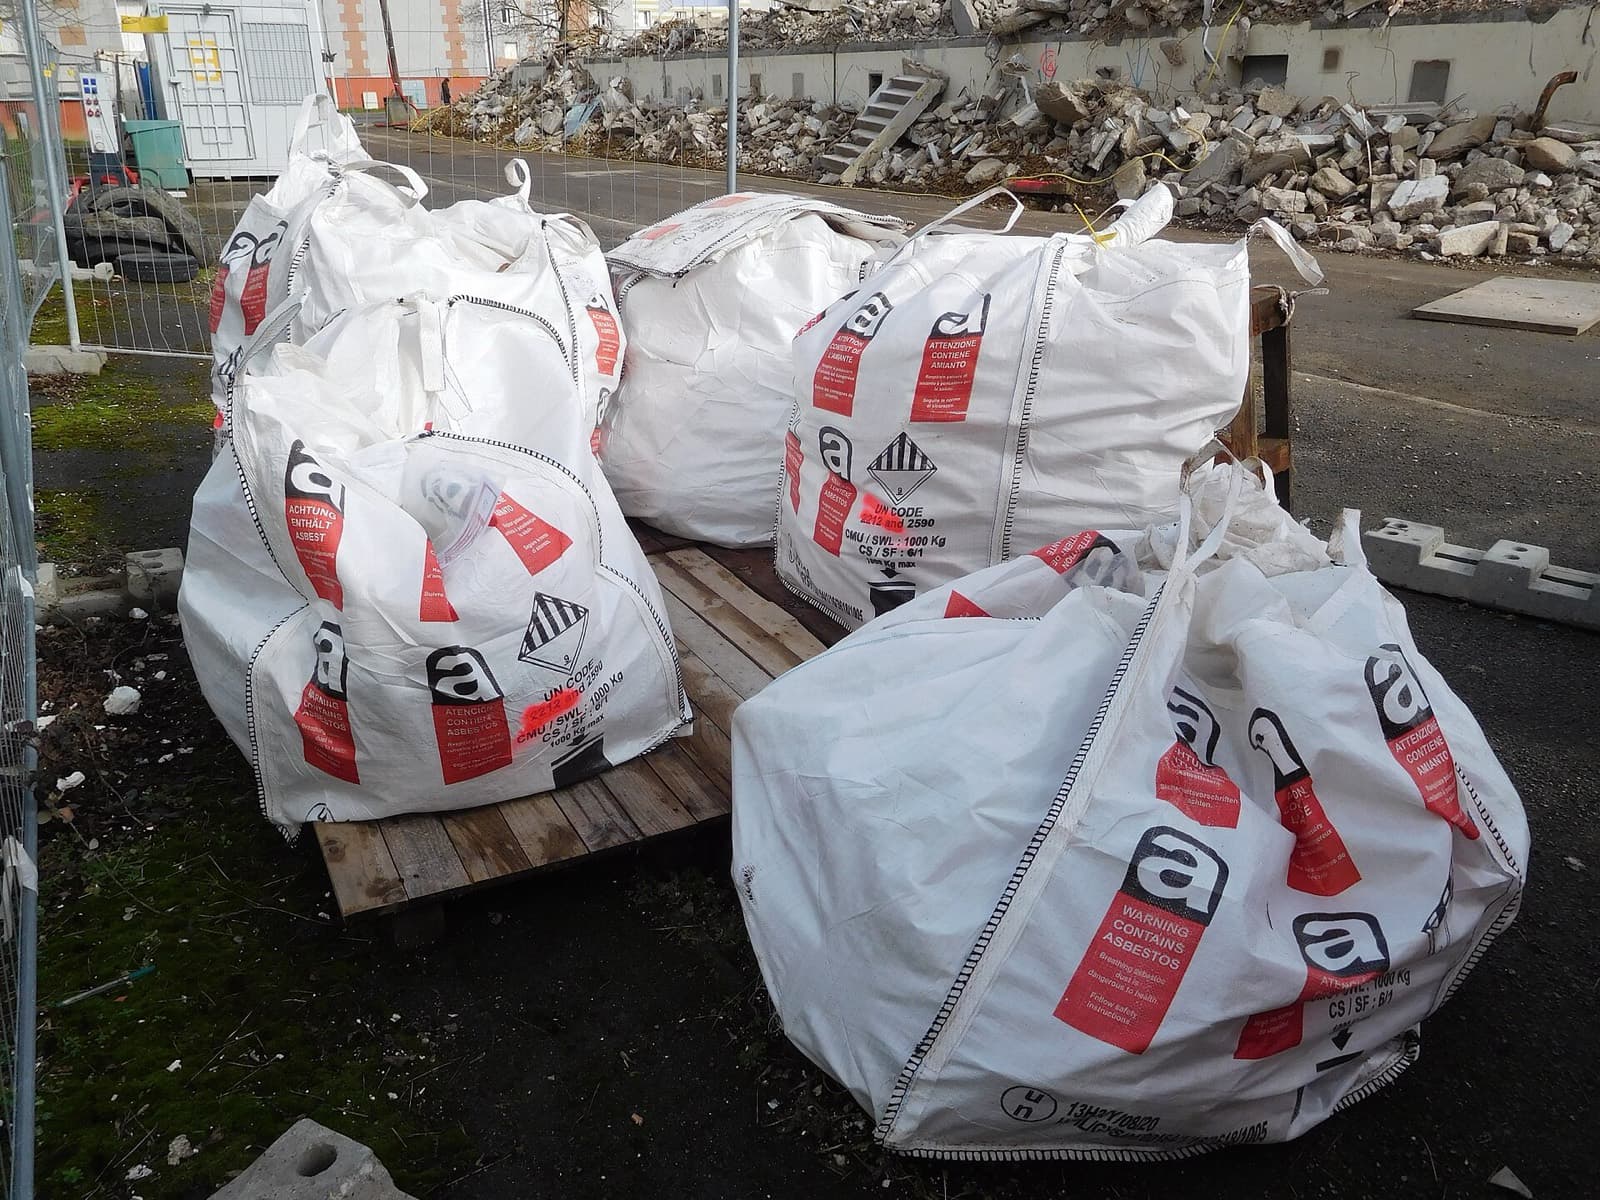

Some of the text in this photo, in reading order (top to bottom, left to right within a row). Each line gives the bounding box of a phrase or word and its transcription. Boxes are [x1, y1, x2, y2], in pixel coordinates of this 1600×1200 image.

[929, 340, 977, 350] ATTENZIONE
[931, 350, 971, 359] CONTIENE
[930, 360, 967, 369] AMIANTO
[821, 428, 851, 481] a
[289, 504, 336, 520] ACHTUNG
[291, 516, 333, 530] ENTHÄLT
[874, 503, 924, 518] UN CODE
[884, 518, 904, 529] and
[906, 518, 935, 529] 2590
[295, 531, 327, 543] ASBEST
[845, 529, 865, 543] CMU
[871, 535, 895, 546] SWL
[903, 535, 928, 547] 1000
[930, 535, 946, 548] Kg
[858, 544, 873, 559] CS
[881, 547, 898, 558] SF
[906, 547, 924, 558] 6/1
[897, 561, 916, 569] max
[430, 649, 502, 701] a
[543, 658, 594, 703] UN CODE
[587, 660, 604, 688] 2590
[1367, 646, 1432, 728] a
[516, 724, 546, 744] CMU
[556, 706, 582, 726] SWL
[589, 683, 610, 706] 1000
[609, 671, 624, 688] Kg
[541, 727, 561, 743] CS
[571, 712, 586, 729] SF
[573, 723, 586, 737] Kg
[587, 712, 605, 728] max
[1395, 720, 1439, 753] ATTENZIONE
[1406, 735, 1445, 764] CONTIENE
[1416, 751, 1449, 776] AMIANTO
[1129, 830, 1224, 920] a
[1122, 904, 1190, 938] WARNING
[1112, 919, 1186, 954] CONTAINS
[1298, 915, 1388, 973] a
[1098, 951, 1134, 974] Breathing
[1102, 932, 1181, 970] ASBESTOS
[1087, 968, 1126, 992] dangerous
[1125, 986, 1135, 994] to
[1115, 972, 1141, 986] dust is
[1396, 967, 1411, 986] Kg
[1089, 991, 1115, 1008] Follow
[1328, 1001, 1346, 1019] CS
[1355, 994, 1370, 1013] SF
[1378, 989, 1394, 1009] 6/1
[1025, 1088, 1045, 1104] u
[1012, 1104, 1034, 1119] n
